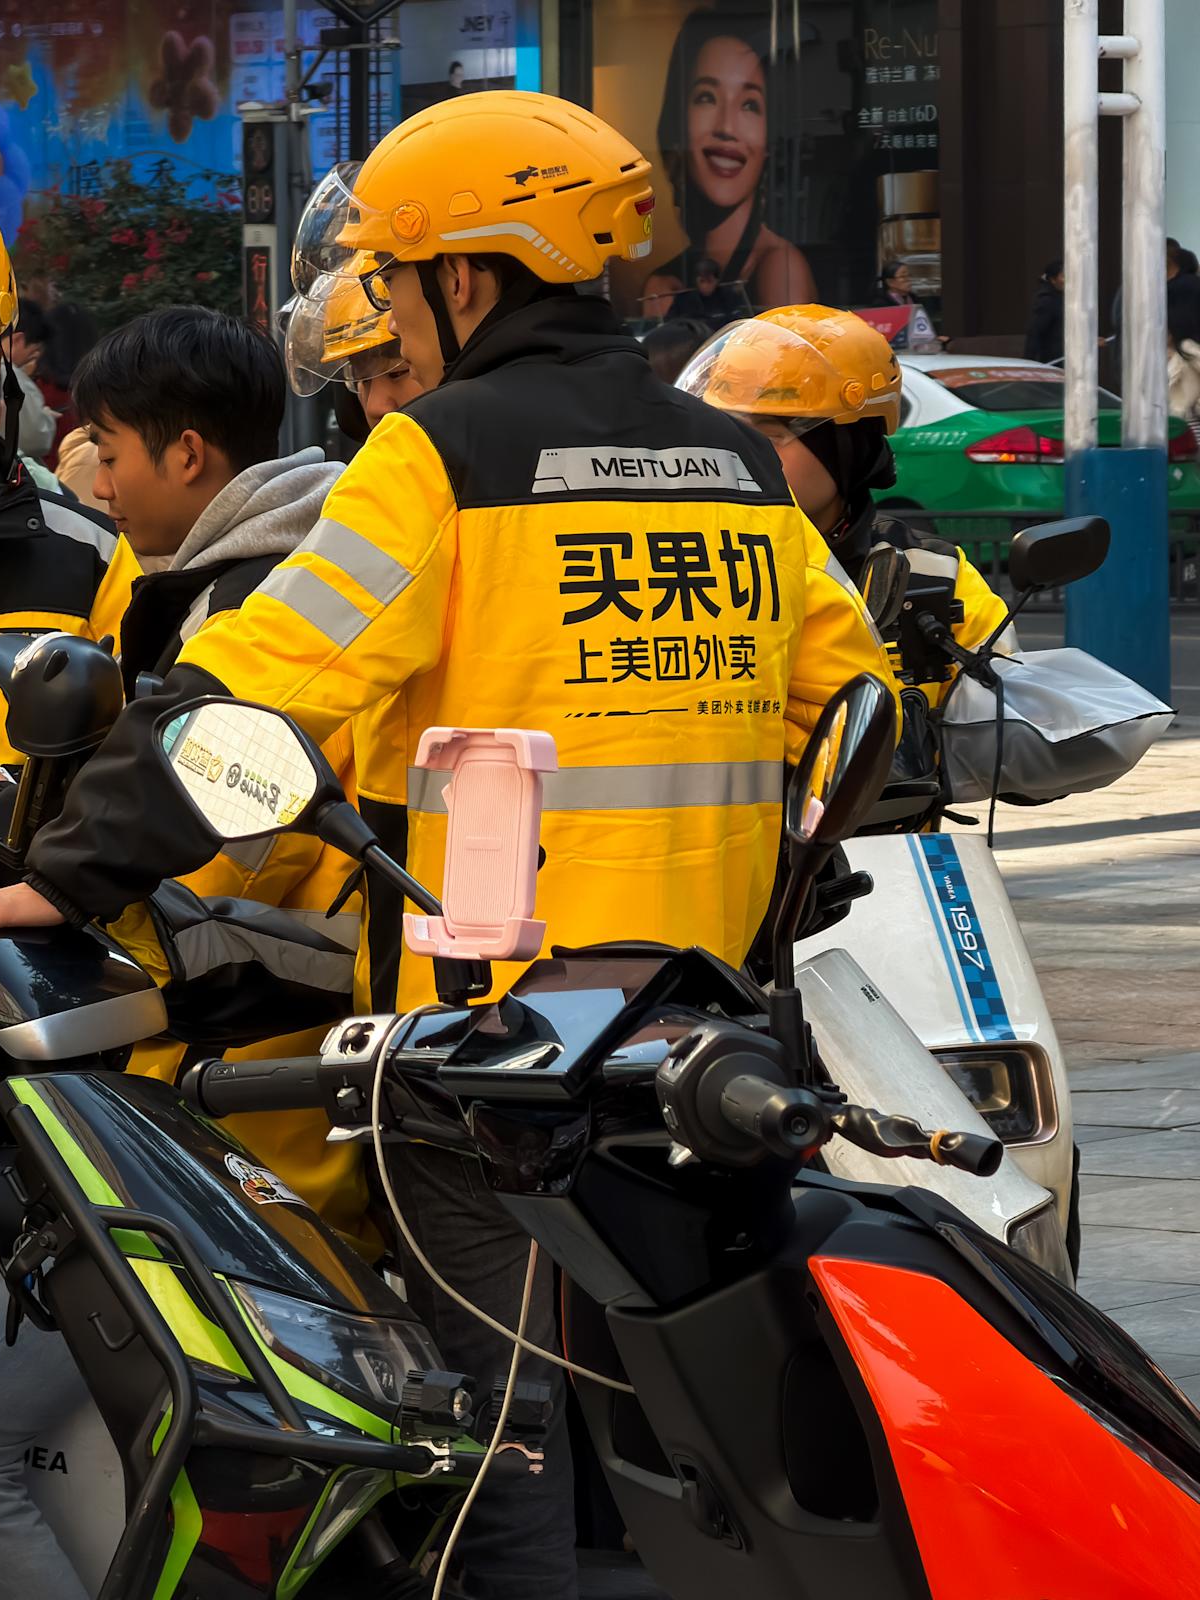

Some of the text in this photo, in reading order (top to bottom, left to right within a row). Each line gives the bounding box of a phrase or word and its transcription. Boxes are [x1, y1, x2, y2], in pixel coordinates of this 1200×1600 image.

[591, 457, 721, 478] MEITUAN
[555, 529, 780, 626] 买果切
[564, 634, 757, 685] 上美团外卖
[697, 700, 744, 715] 美团外卖
[943, 874, 957, 901] YADEA
[950, 905, 986, 972] 1997
